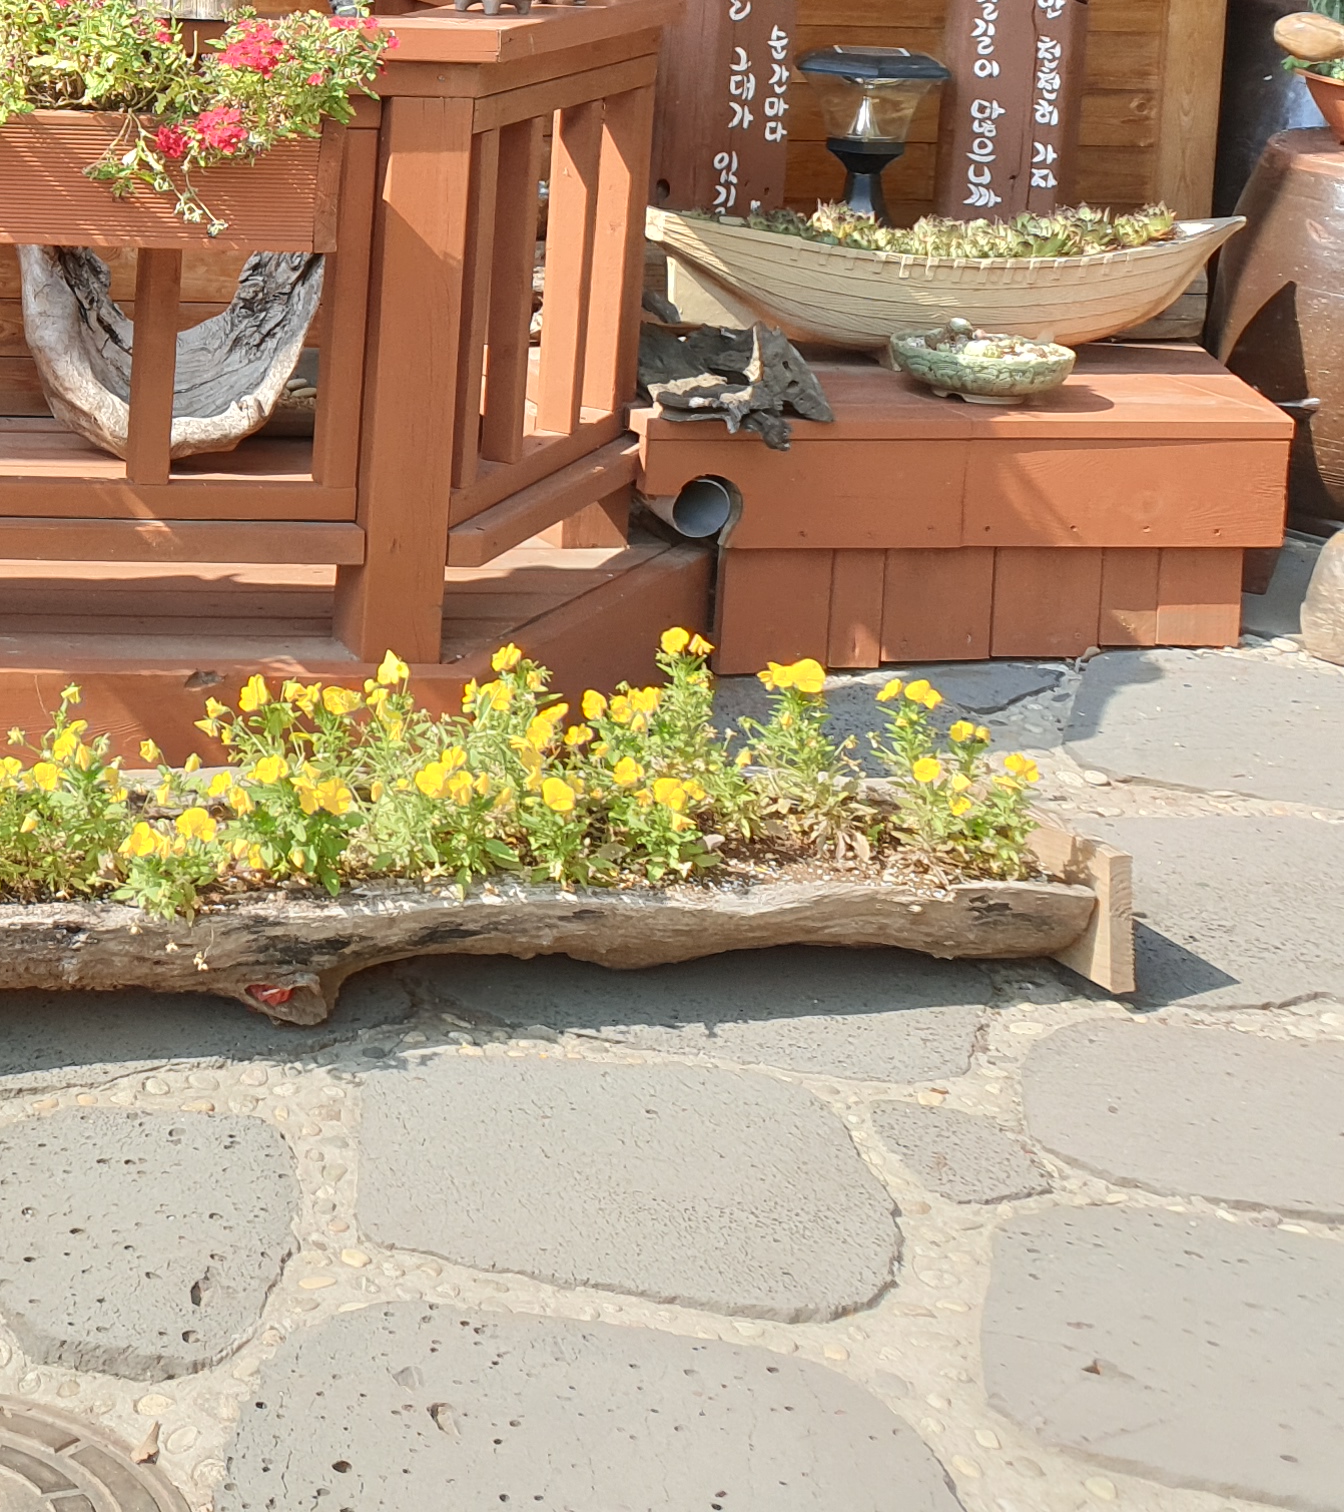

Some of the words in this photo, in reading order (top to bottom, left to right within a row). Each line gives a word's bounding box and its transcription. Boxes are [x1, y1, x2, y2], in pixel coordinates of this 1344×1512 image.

[728, 46, 756, 129] 그대가
[764, 24, 789, 142] 순간마다
[1033, 36, 1061, 126] 천천히
[963, 99, 1006, 208] 많으니까
[1031, 141, 1058, 188] 가자
